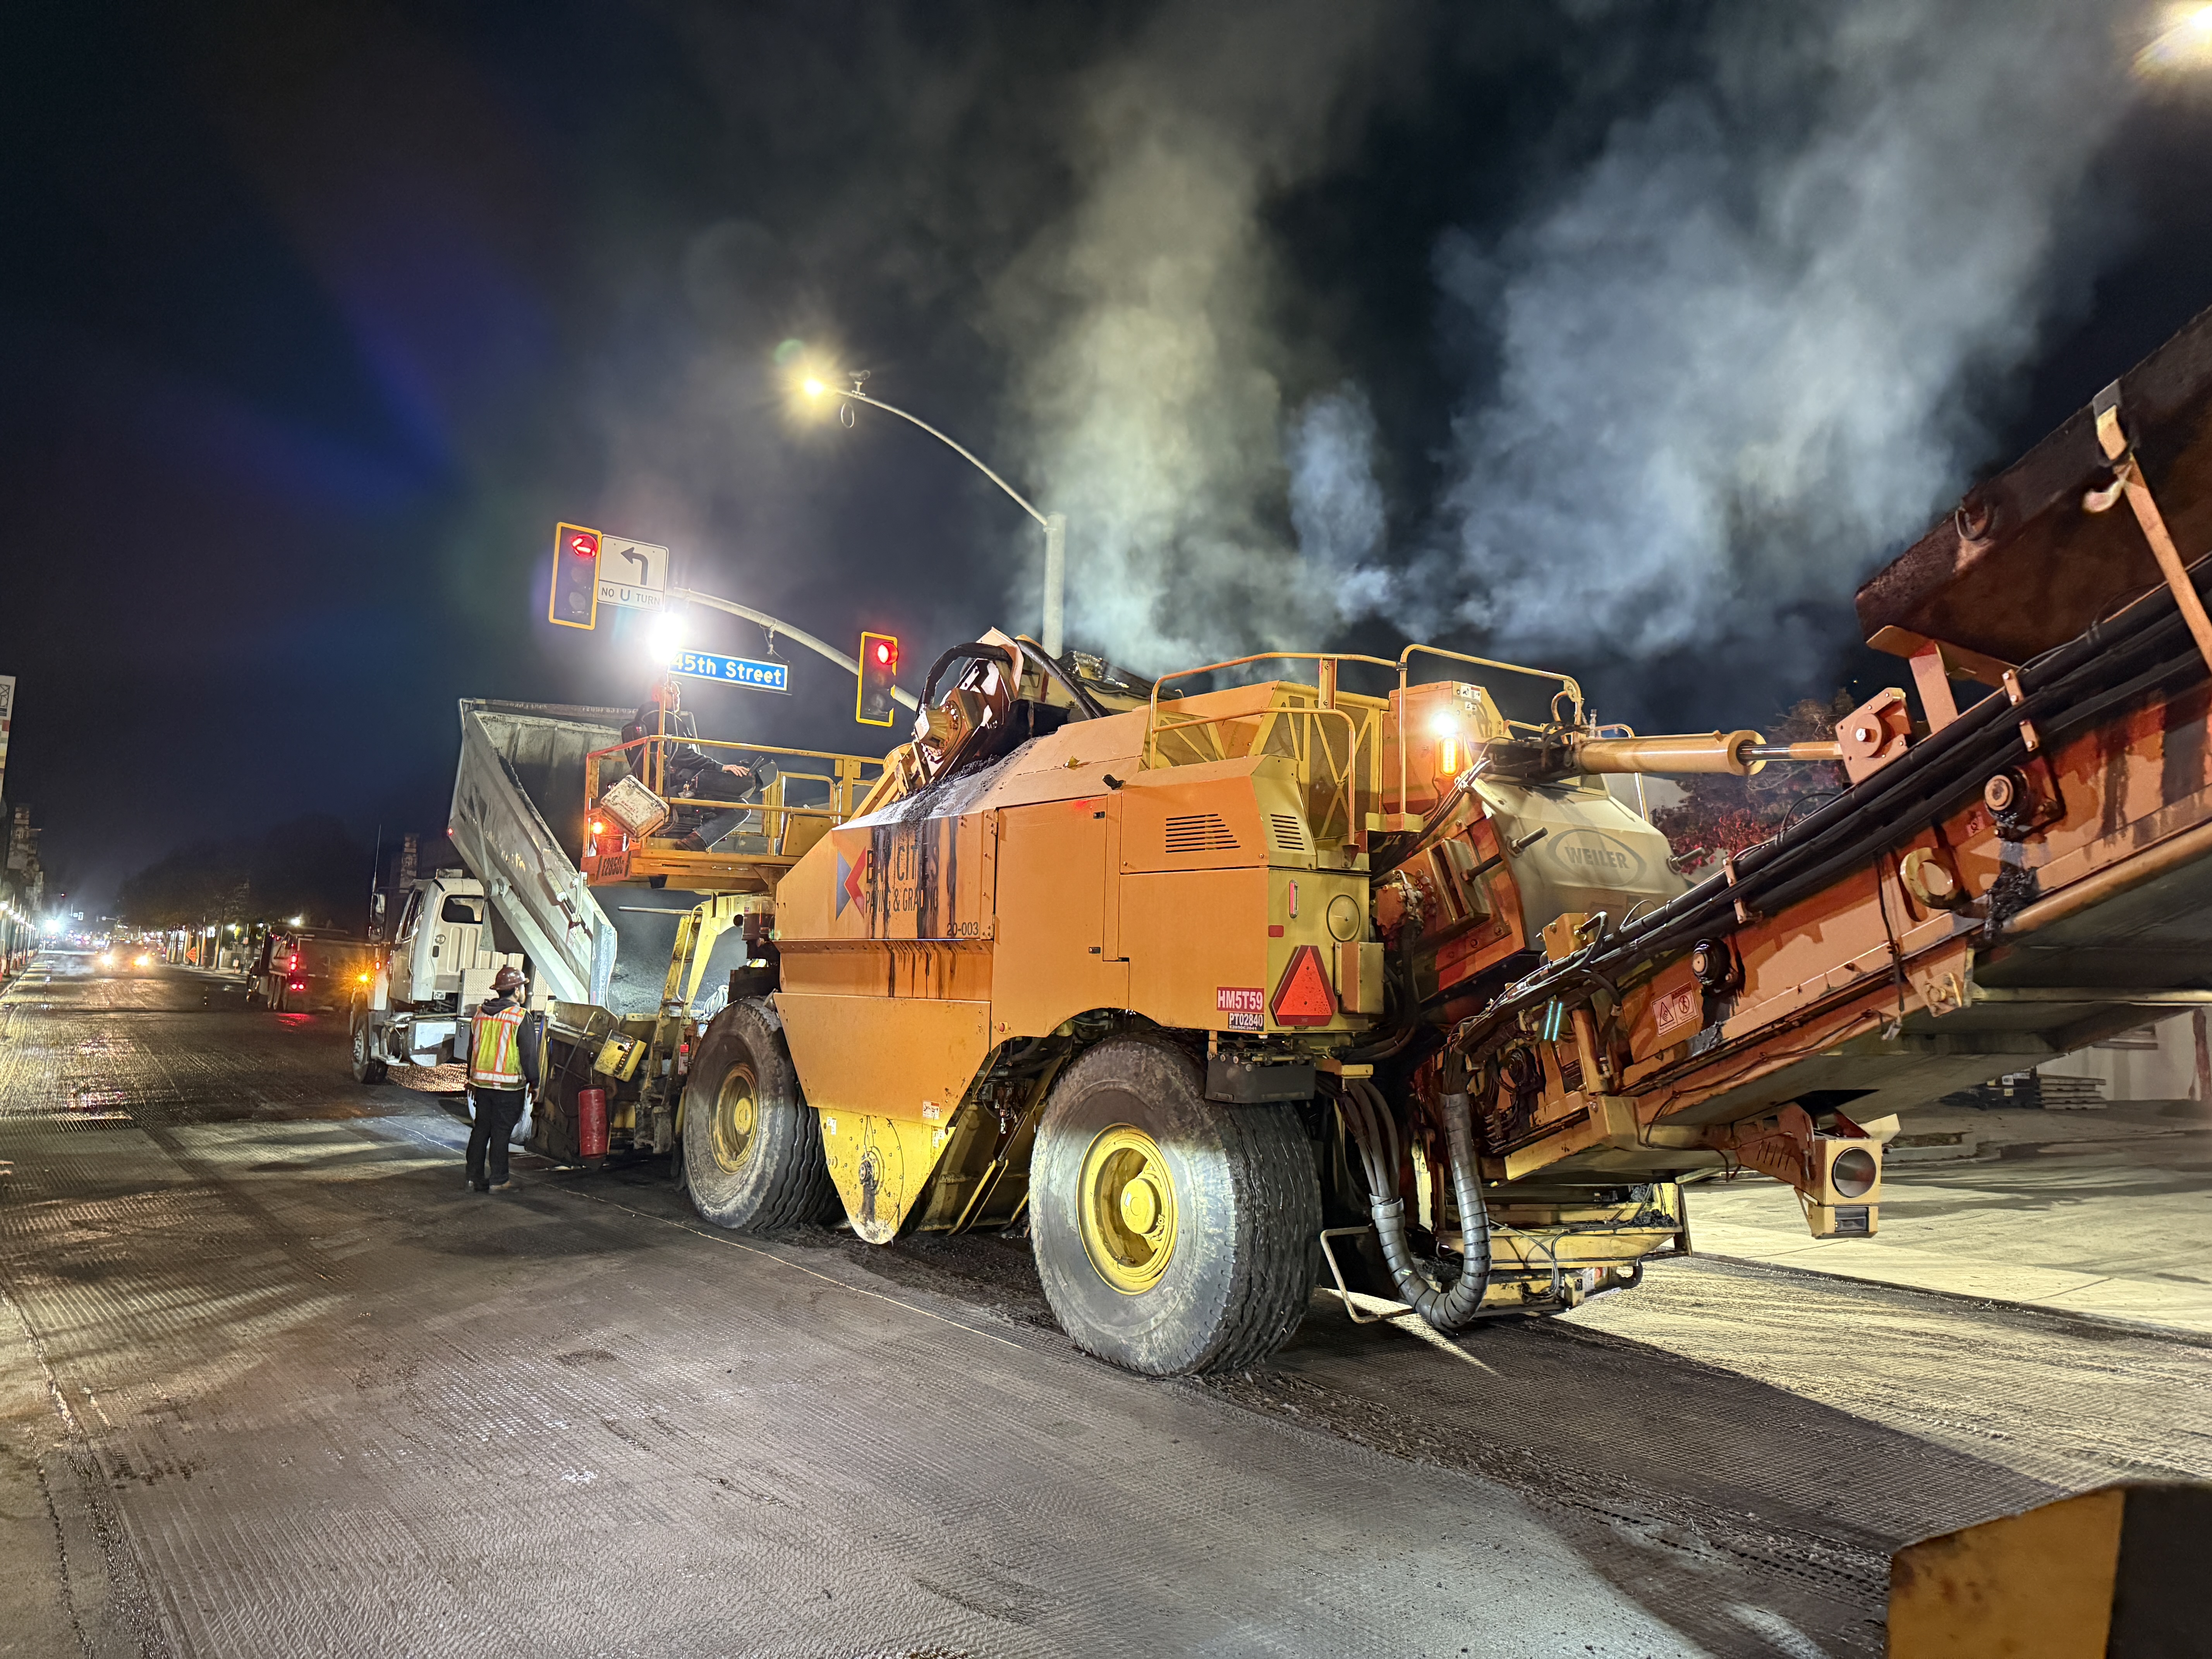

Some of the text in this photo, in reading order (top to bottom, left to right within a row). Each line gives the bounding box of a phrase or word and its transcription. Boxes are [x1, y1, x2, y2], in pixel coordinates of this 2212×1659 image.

[601, 587, 660, 606] NO U TURN
[670, 653, 781, 685] 45th Street
[866, 843, 939, 883] BA CITS
[1564, 846, 1630, 869] WEILER
[866, 886, 938, 913] PAING & GRADG
[946, 921, 979, 936] 20-003
[1218, 990, 1263, 1010] HM5T59
[1229, 1012, 1263, 1027] PT02840
